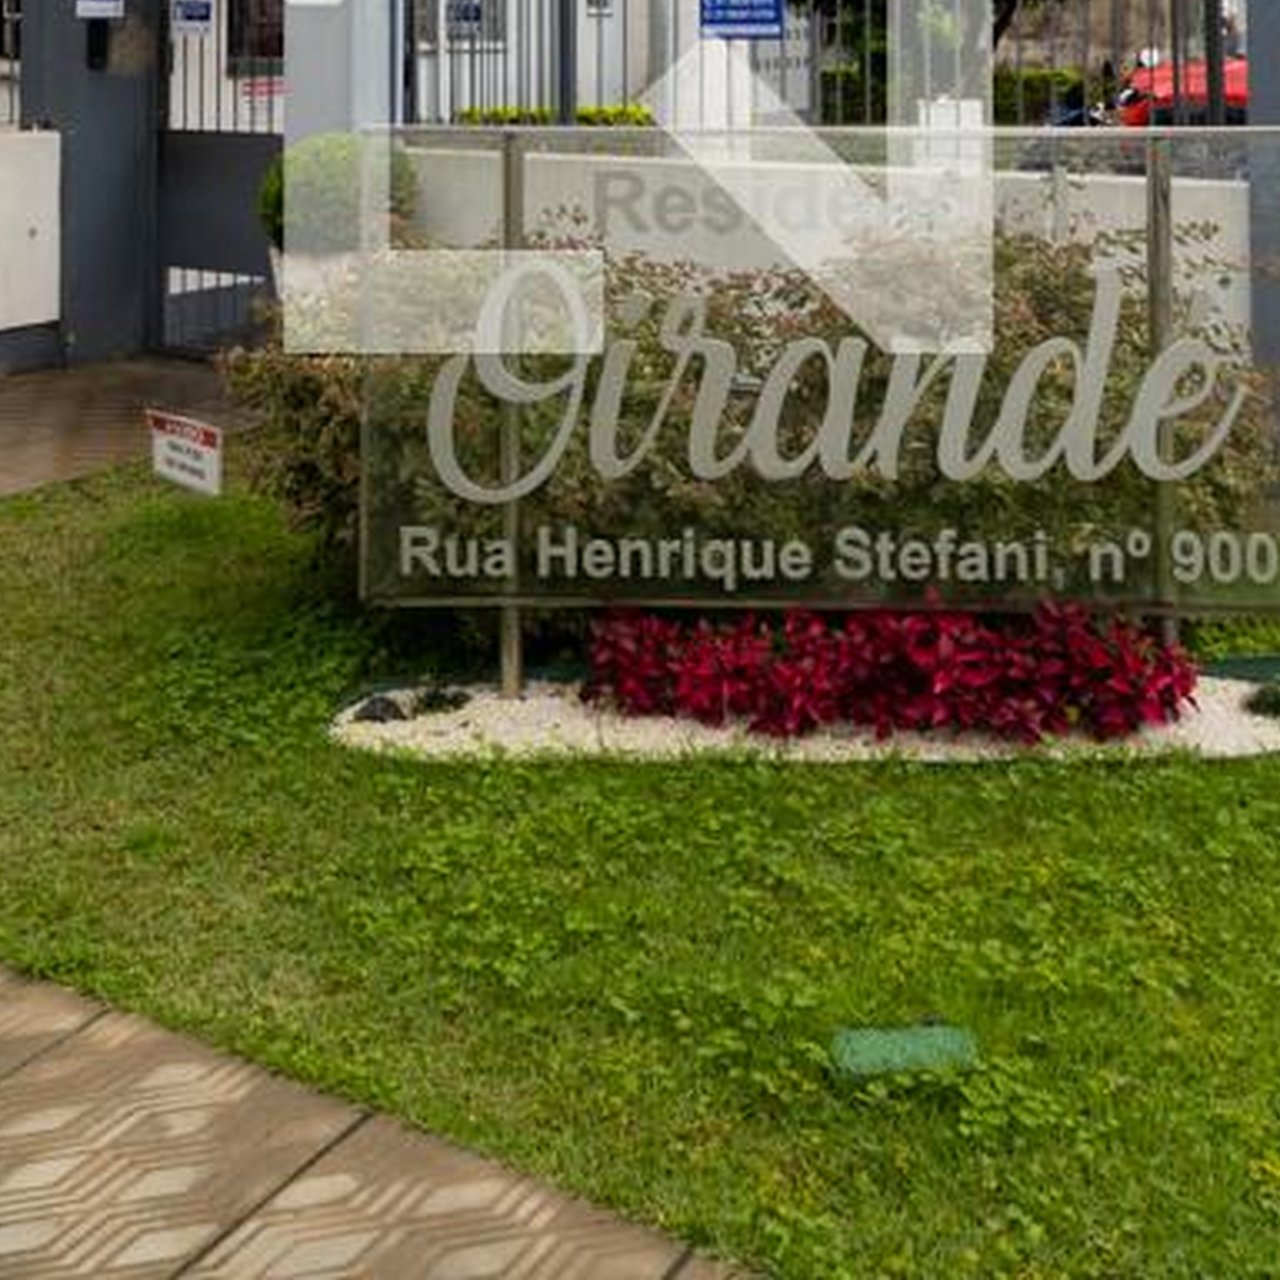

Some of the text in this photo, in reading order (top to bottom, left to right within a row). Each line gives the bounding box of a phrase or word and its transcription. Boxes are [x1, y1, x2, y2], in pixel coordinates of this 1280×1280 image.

[398, 526, 514, 578] Rua
[535, 525, 814, 592] Henrique
[833, 525, 1066, 590] Stefani,
[1170, 529, 1280, 584] 900
